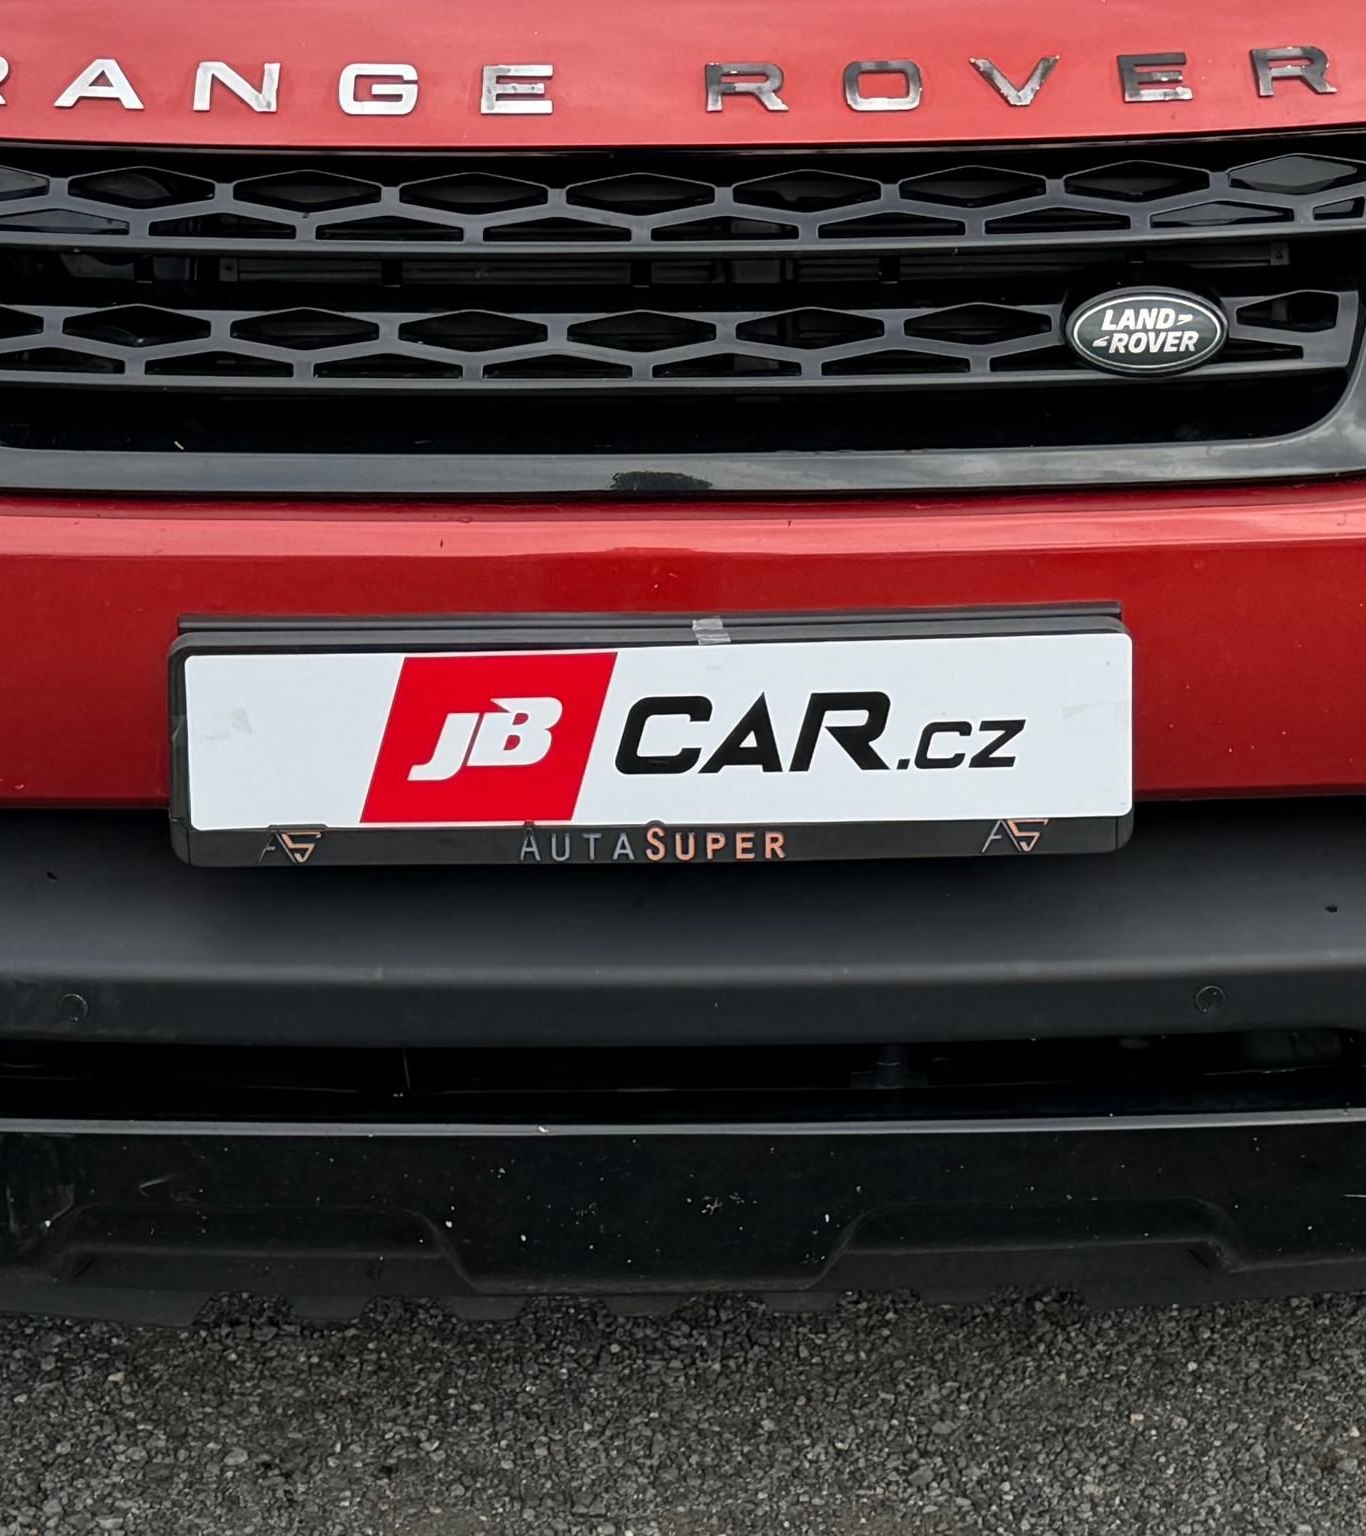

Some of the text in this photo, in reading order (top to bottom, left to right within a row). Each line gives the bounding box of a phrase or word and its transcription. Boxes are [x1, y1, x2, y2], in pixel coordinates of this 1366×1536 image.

[703, 45, 1338, 113] ROVER
[1101, 308, 1176, 331] LAND
[1108, 331, 1199, 354] ROVER
[407, 697, 563, 781] JB
